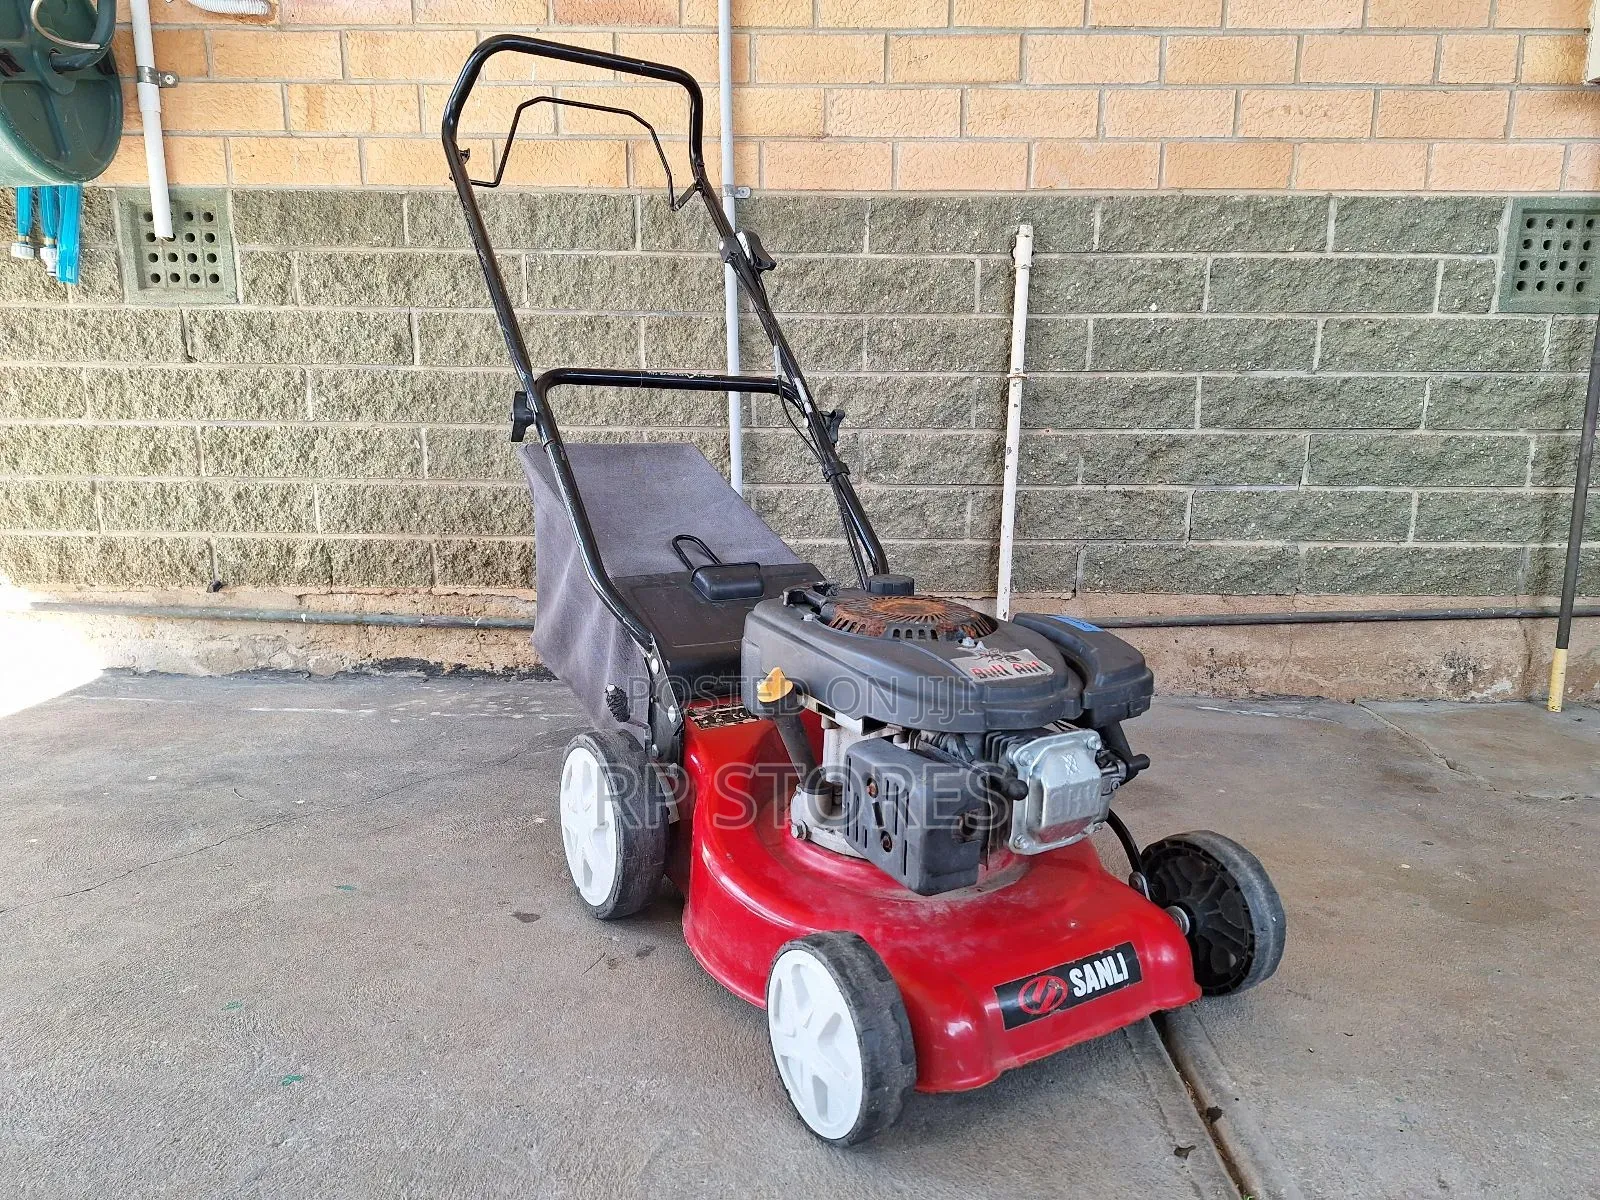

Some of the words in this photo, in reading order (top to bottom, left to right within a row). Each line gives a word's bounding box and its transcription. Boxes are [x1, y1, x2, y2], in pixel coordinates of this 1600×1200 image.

[971, 664, 1012, 679] Bull
[1012, 660, 1046, 675] Ant
[1069, 952, 1129, 998] SANLI
